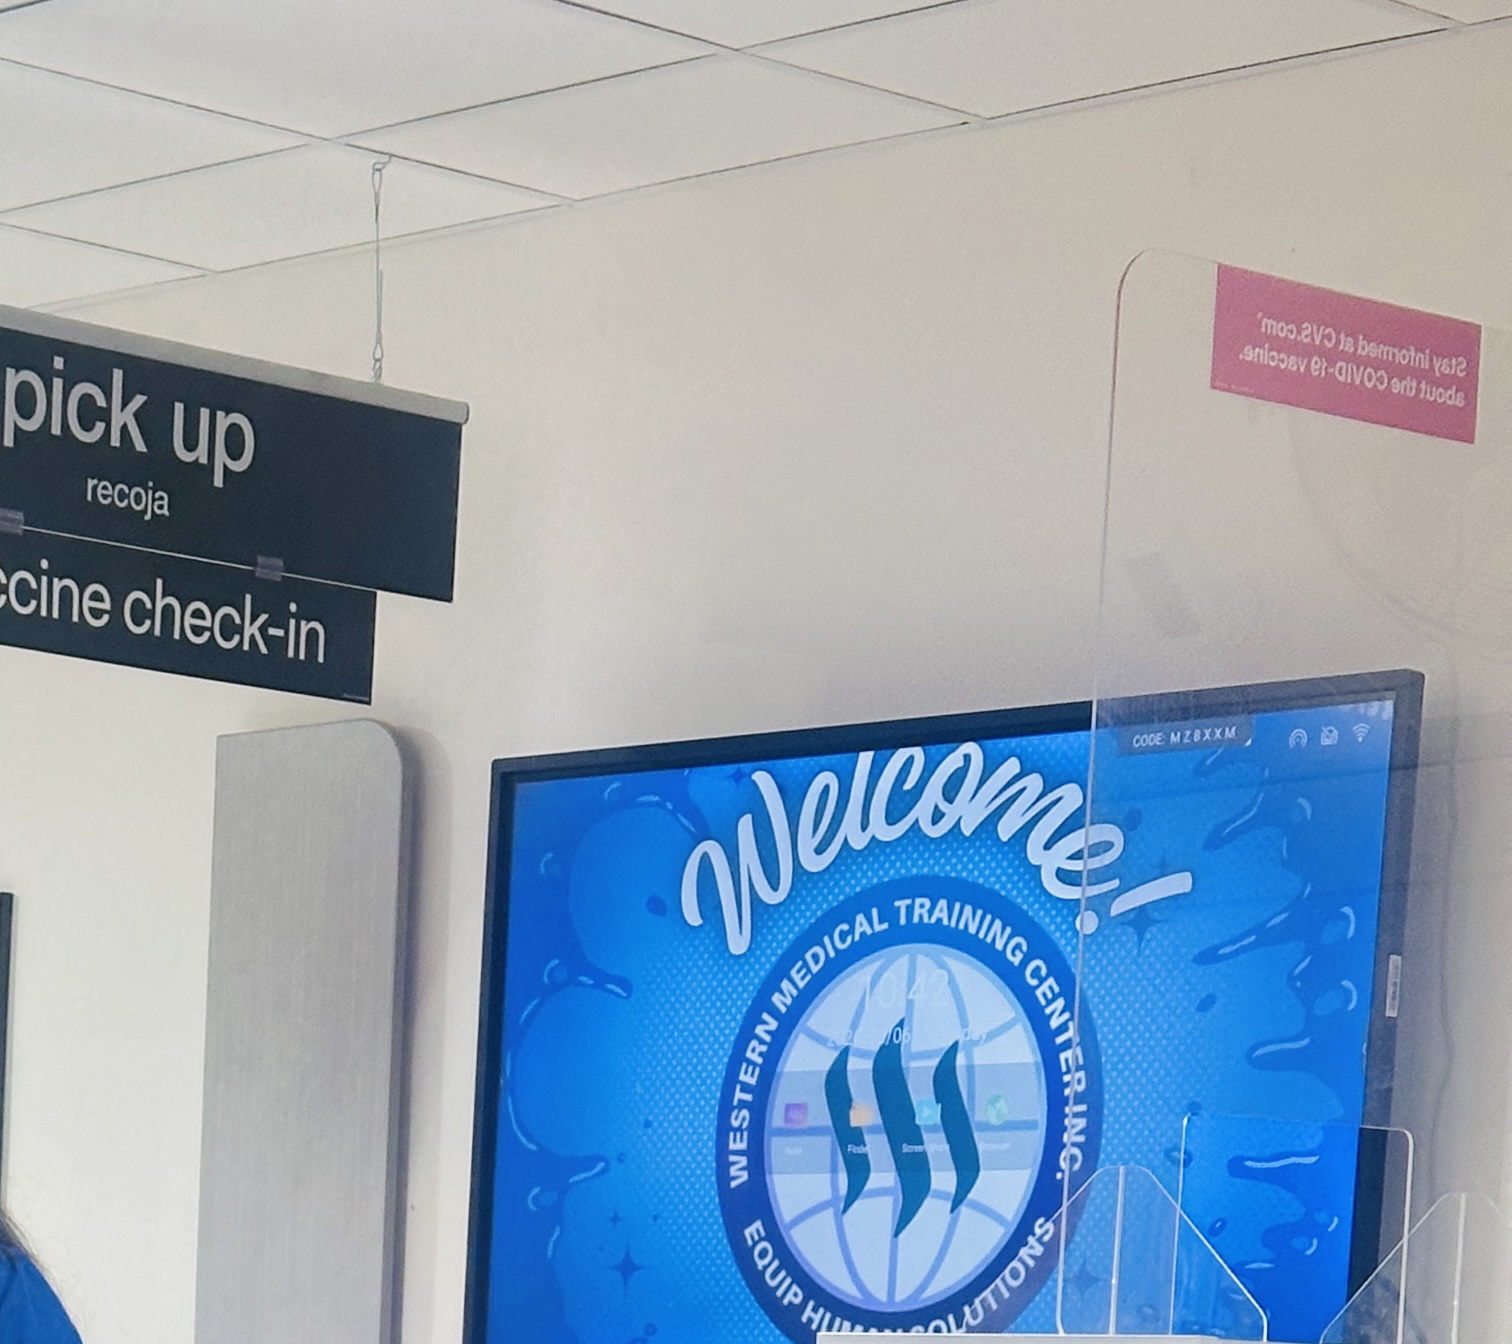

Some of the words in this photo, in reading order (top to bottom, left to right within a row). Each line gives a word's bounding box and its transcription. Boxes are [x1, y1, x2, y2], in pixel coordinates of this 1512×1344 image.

[2, 356, 148, 453] pick
[172, 400, 256, 487] up
[86, 476, 170, 521] recoja
[123, 579, 326, 665] check-in
[1132, 733, 1166, 748] CODE:
[681, 741, 1193, 955] Welcome!
[771, 907, 889, 1014] MEDICAL
[894, 897, 1028, 968] TRAINING
[1025, 959, 1088, 1096] CENTER
[728, 1012, 779, 1189] WESTERN
[1056, 1104, 1088, 1181] INC.
[743, 1219, 804, 1307] EQUIP
